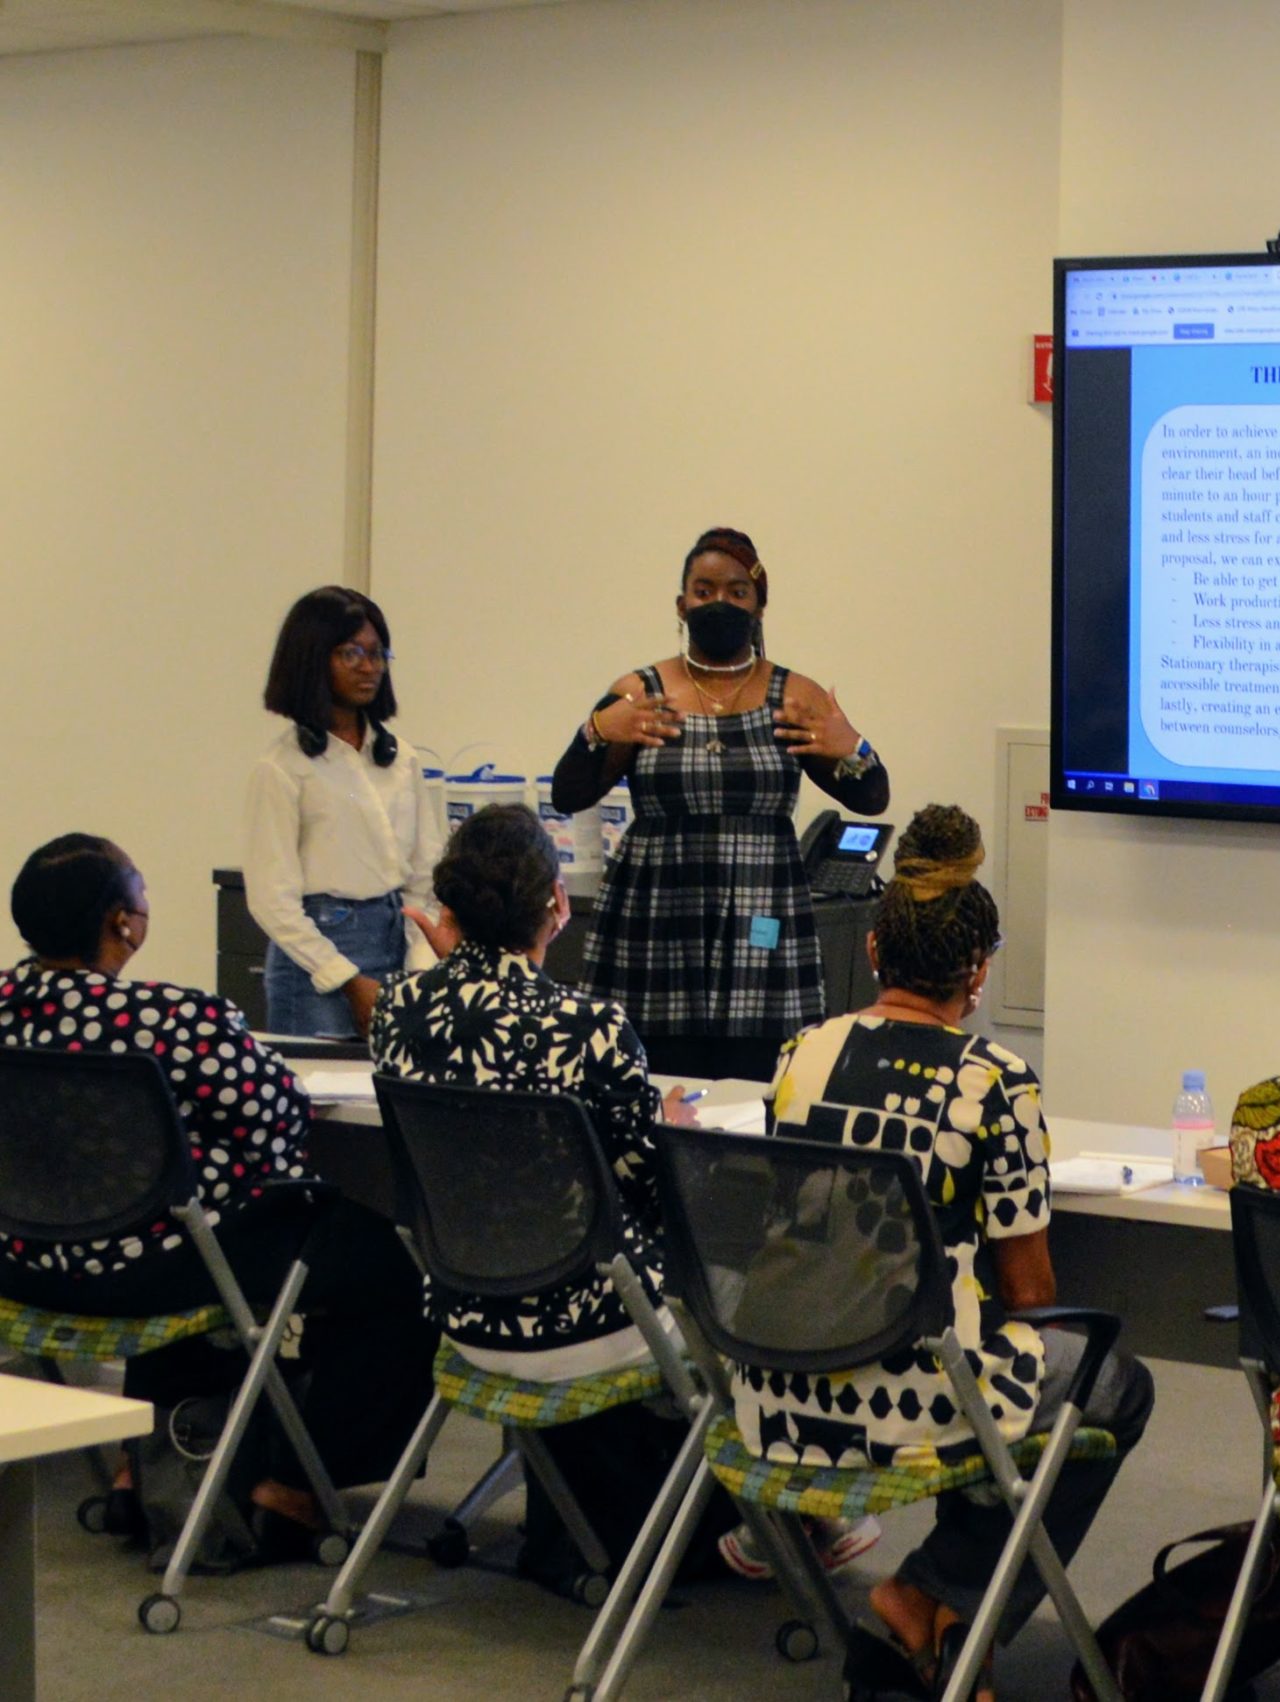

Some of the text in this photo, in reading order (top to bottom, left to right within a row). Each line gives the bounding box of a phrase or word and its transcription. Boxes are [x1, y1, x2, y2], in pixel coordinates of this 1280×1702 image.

[1163, 423, 1176, 439] In
[1178, 423, 1213, 439] order
[1215, 425, 1229, 439] to
[1231, 423, 1279, 439] achieve
[1161, 445, 1243, 462] environment,
[1245, 449, 1262, 460] an
[1161, 466, 1193, 481] clear
[1194, 466, 1225, 482] their
[1227, 466, 1258, 482] head
[1161, 487, 1205, 502] minute
[1206, 489, 1220, 502] to
[1222, 492, 1239, 502] an
[1241, 487, 1272, 503] hour
[1161, 507, 1214, 523] students
[1216, 508, 1240, 524] and
[1242, 508, 1273, 524] staff
[1160, 528, 1184, 544] and
[1187, 529, 1211, 544] less
[1213, 531, 1251, 545] stress
[1253, 529, 1273, 545] for
[1161, 550, 1217, 570] proposal,
[1220, 556, 1239, 566] we
[1241, 556, 1264, 567] can
[1194, 571, 1209, 586] Be
[1213, 571, 1238, 587] able
[1242, 574, 1255, 587] to
[1259, 574, 1277, 592] get
[1193, 592, 1227, 608] Work
[1193, 613, 1221, 629] Less
[1225, 616, 1262, 630] stress
[1193, 634, 1256, 656] Flexibility
[1259, 637, 1272, 652] in
[1160, 654, 1223, 676] Stationary
[1159, 677, 1221, 693] accessible
[1160, 696, 1198, 717] lastly,
[1201, 700, 1252, 719] creating
[1254, 705, 1271, 716] an
[1160, 717, 1211, 734] between
